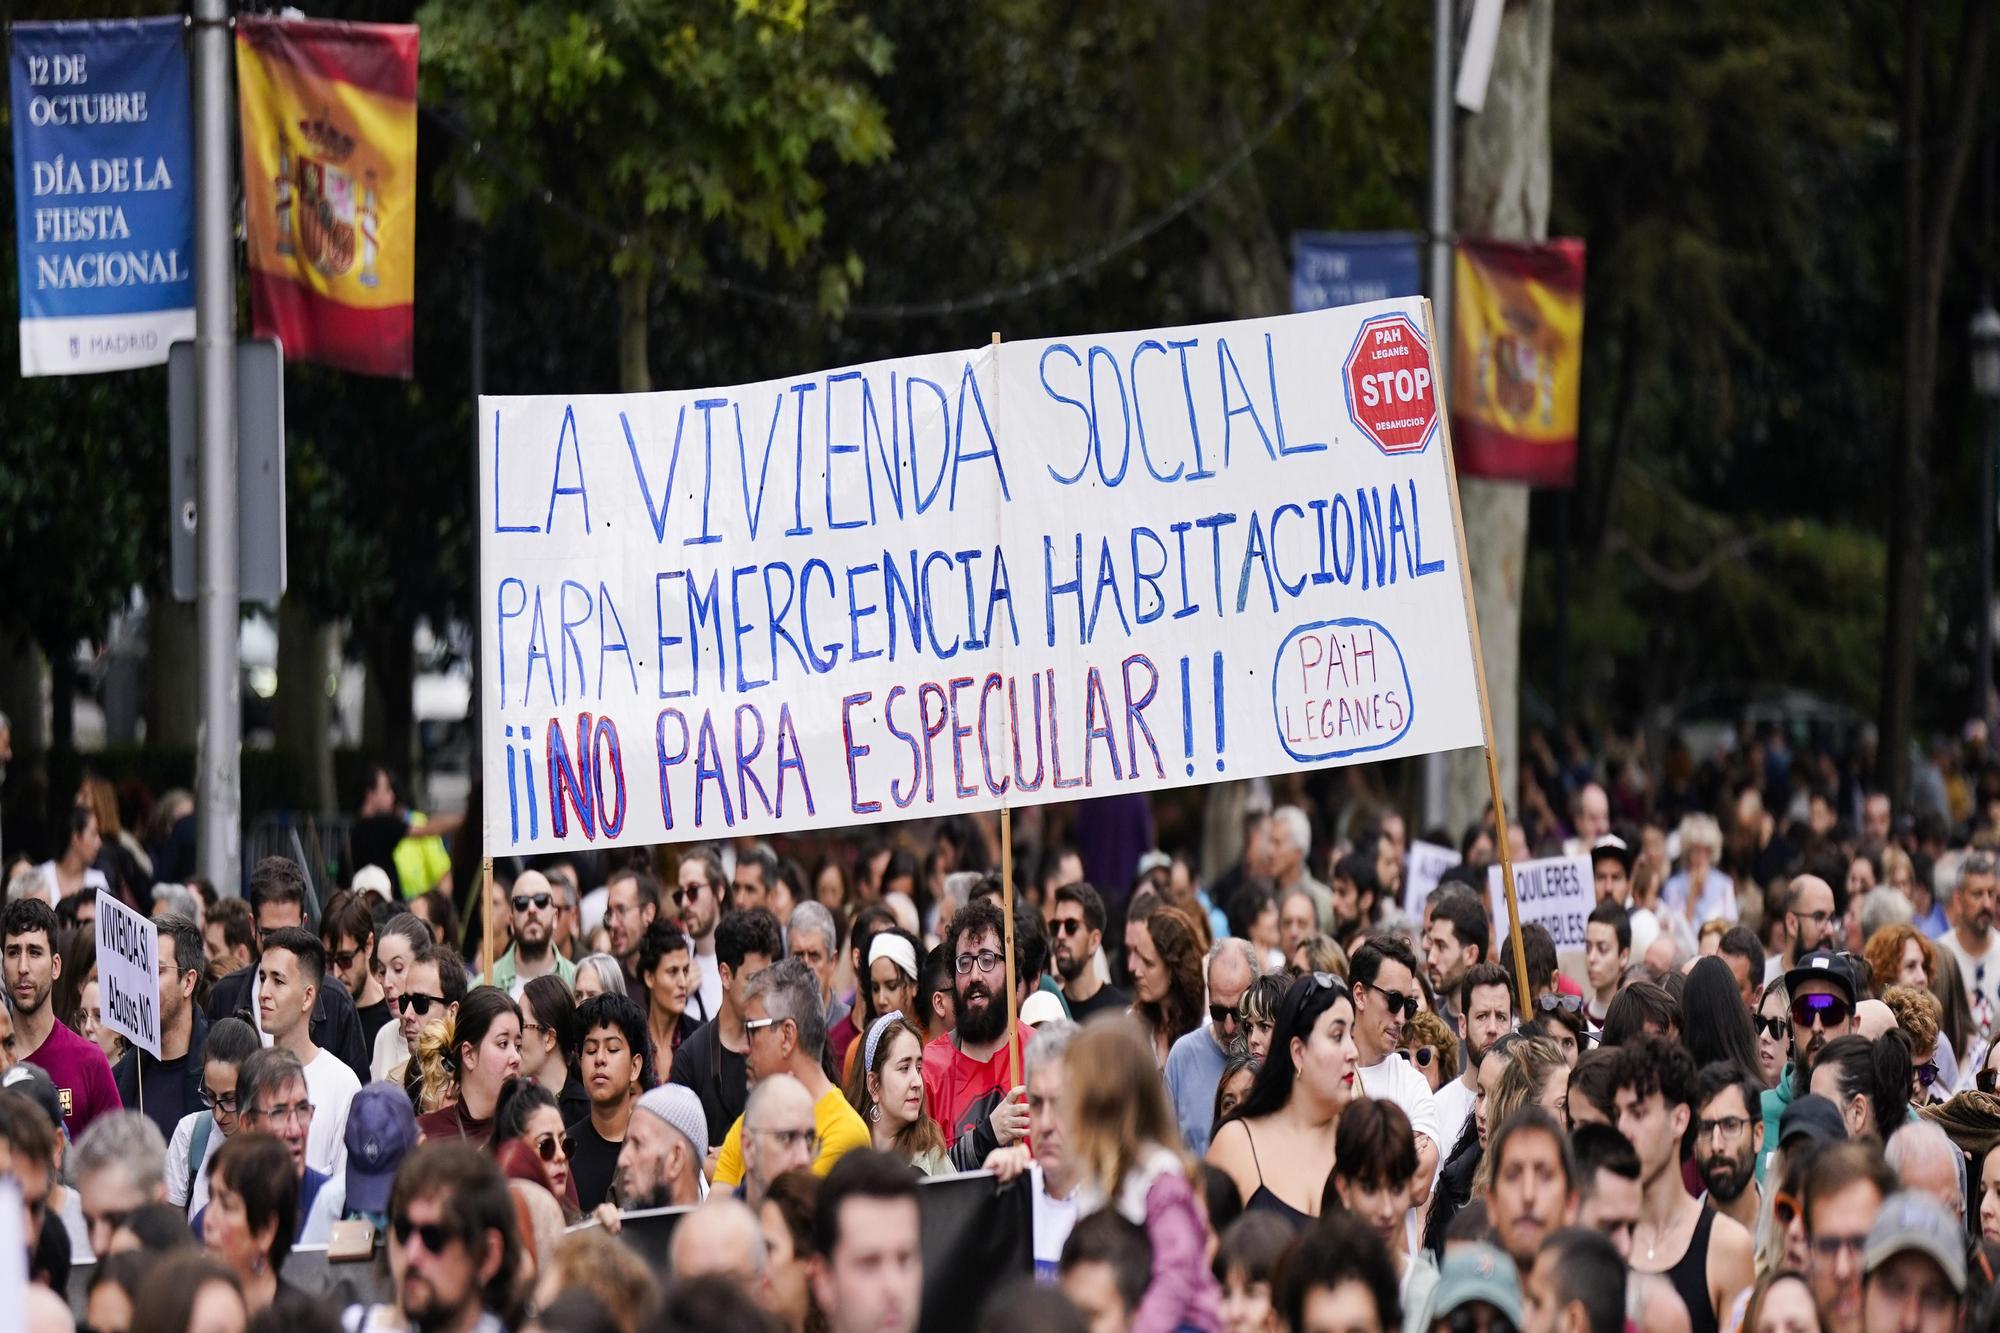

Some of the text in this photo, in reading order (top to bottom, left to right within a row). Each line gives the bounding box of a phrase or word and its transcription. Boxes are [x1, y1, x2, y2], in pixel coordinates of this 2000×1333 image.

[29, 54, 88, 86] 12 DE
[29, 91, 148, 127] OCTUBRE
[33, 153, 173, 196] DÍA DE LA
[35, 205, 131, 242] FIESTA
[37, 249, 189, 289] NACIONAL
[90, 329, 158, 354] MADRID
[1371, 346, 1409, 360] LEGANÉS
[1375, 328, 1402, 345] PAH
[1361, 367, 1431, 407] STOP
[494, 333, 1328, 545] LA VIVIENDA SOCIAL
[1375, 417, 1425, 431] DESAHUCIOS
[498, 479, 1445, 710] PARA EMERGENCIA HABITACIONAL
[1298, 628, 1377, 694] PAH
[1285, 691, 1403, 743] LEGANES
[656, 702, 816, 830] PARA
[101, 900, 141, 968] VIVIENDA
[109, 974, 138, 1035] Abusos
